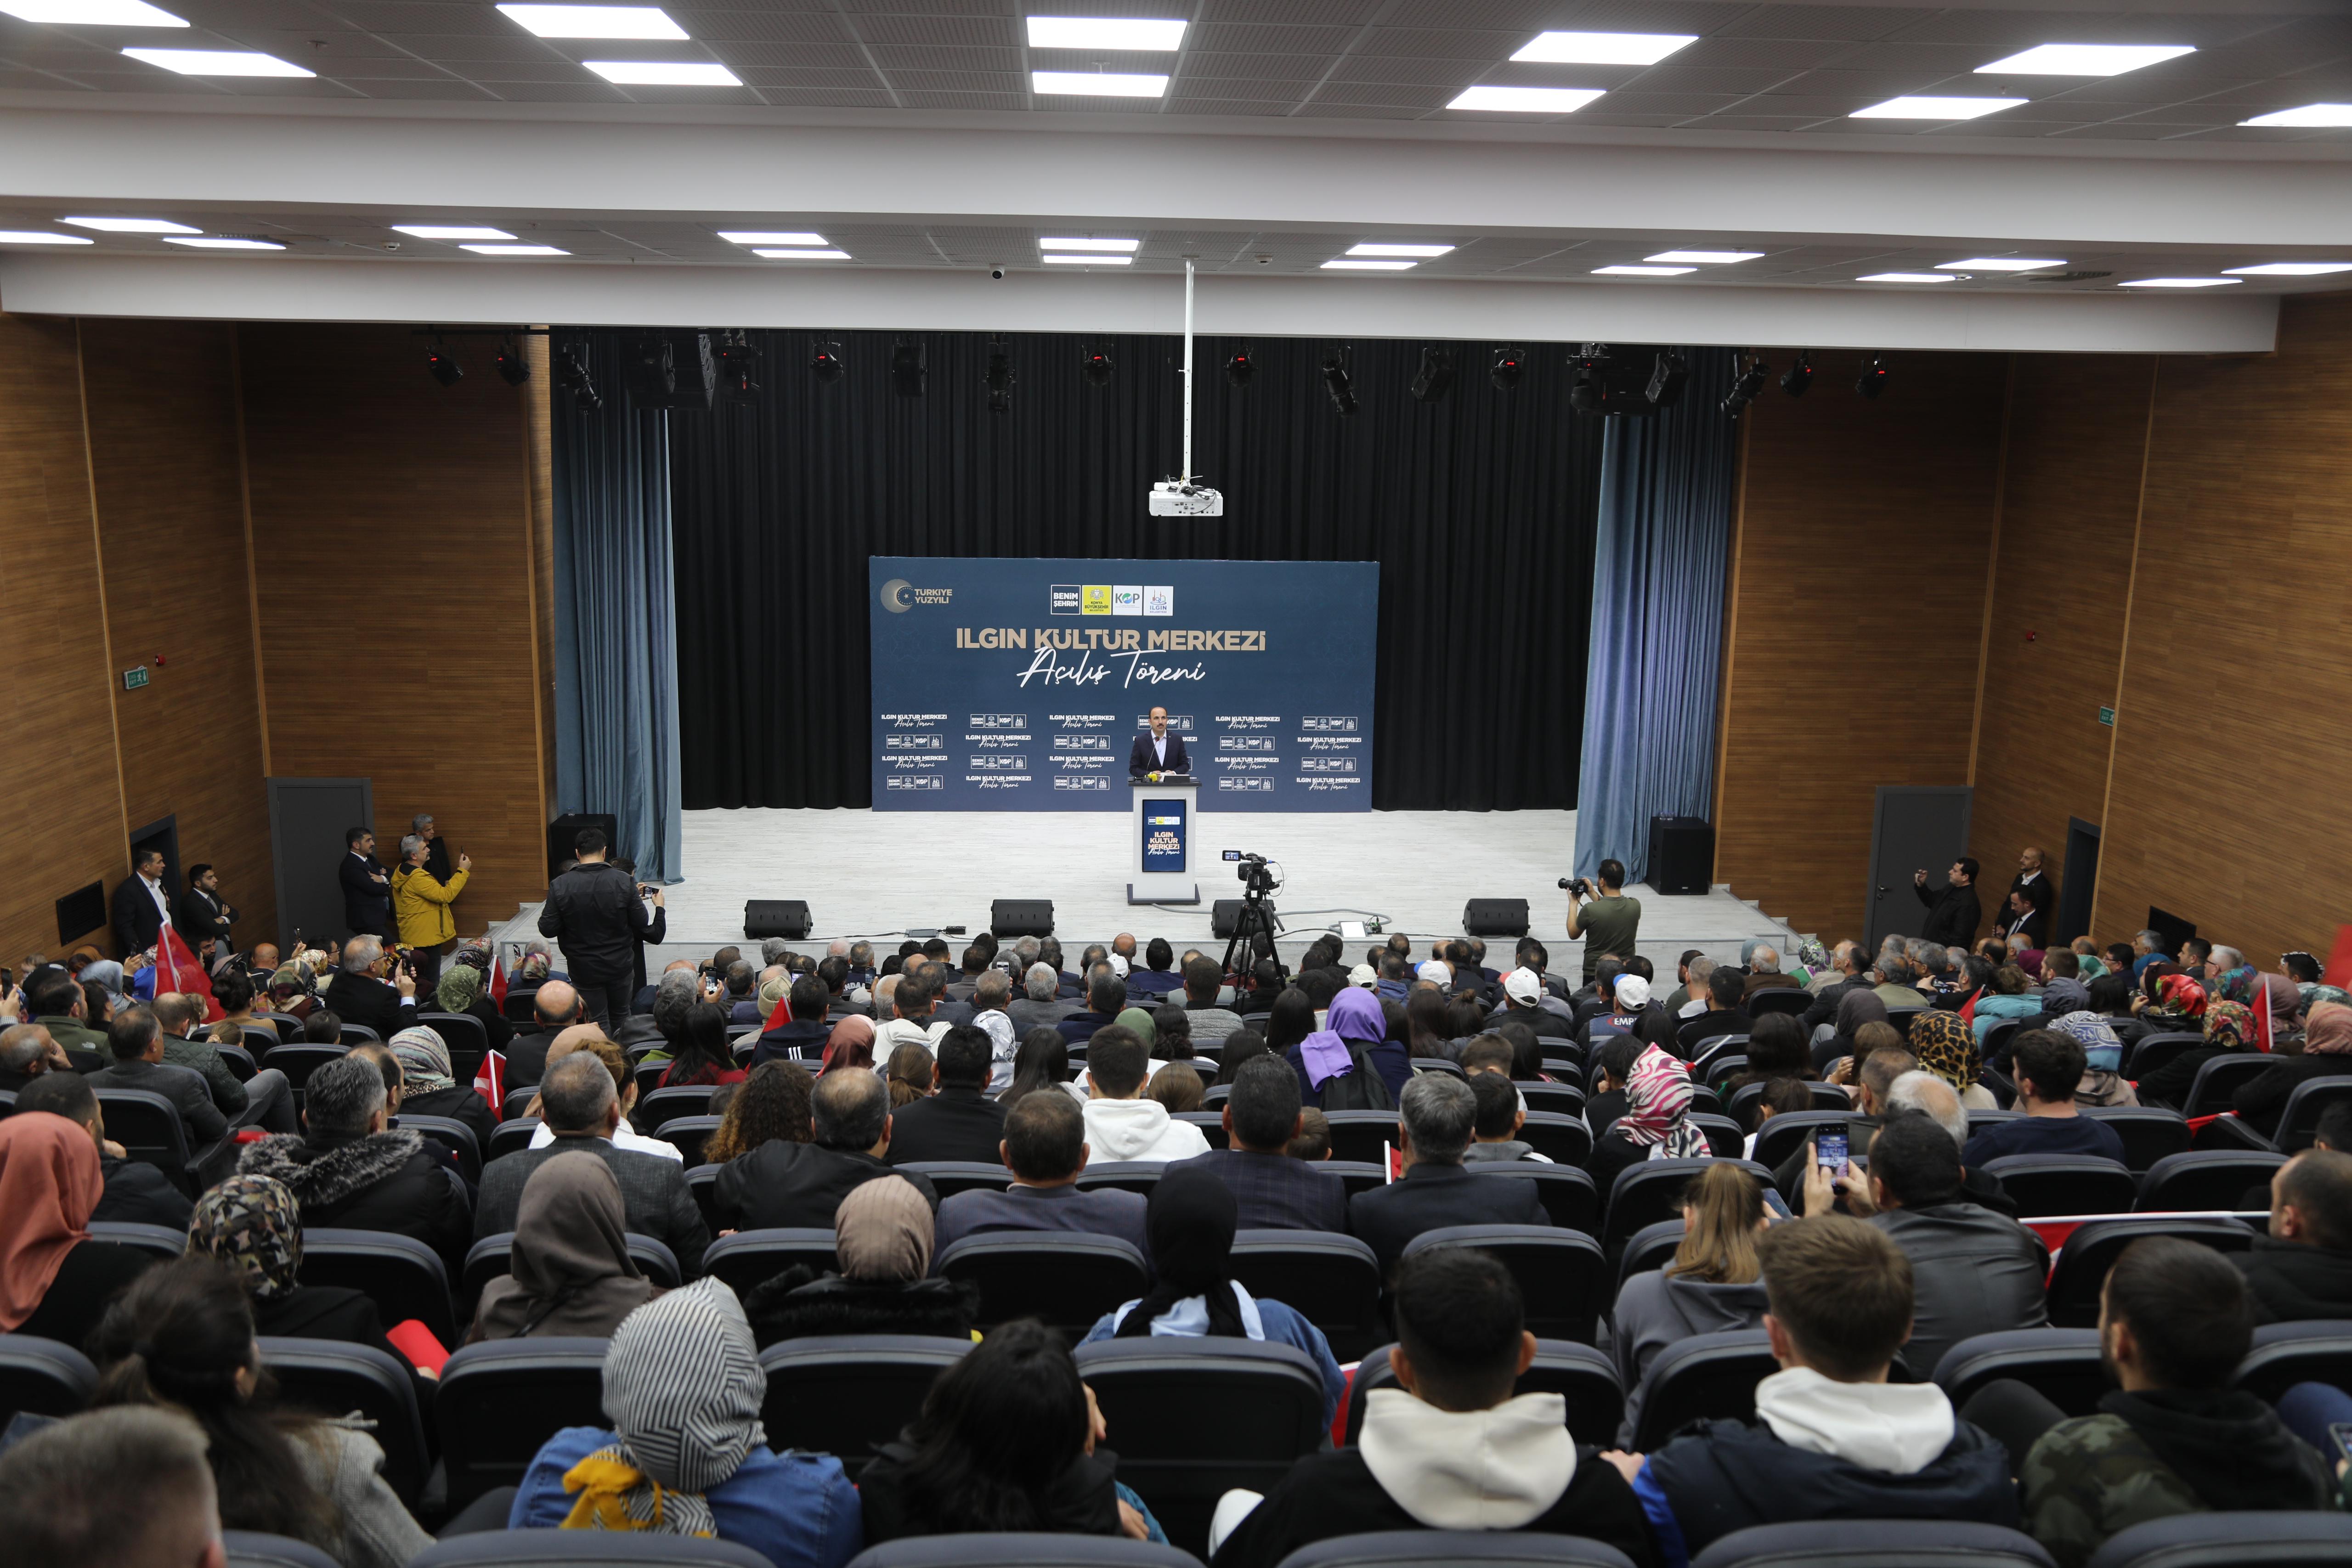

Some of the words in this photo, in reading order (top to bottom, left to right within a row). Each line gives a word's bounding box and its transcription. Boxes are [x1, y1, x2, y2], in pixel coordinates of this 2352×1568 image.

[1115, 593, 1140, 604] KOP
[957, 628, 1026, 649] ILGIN
[1110, 649, 1205, 688] Töreni
